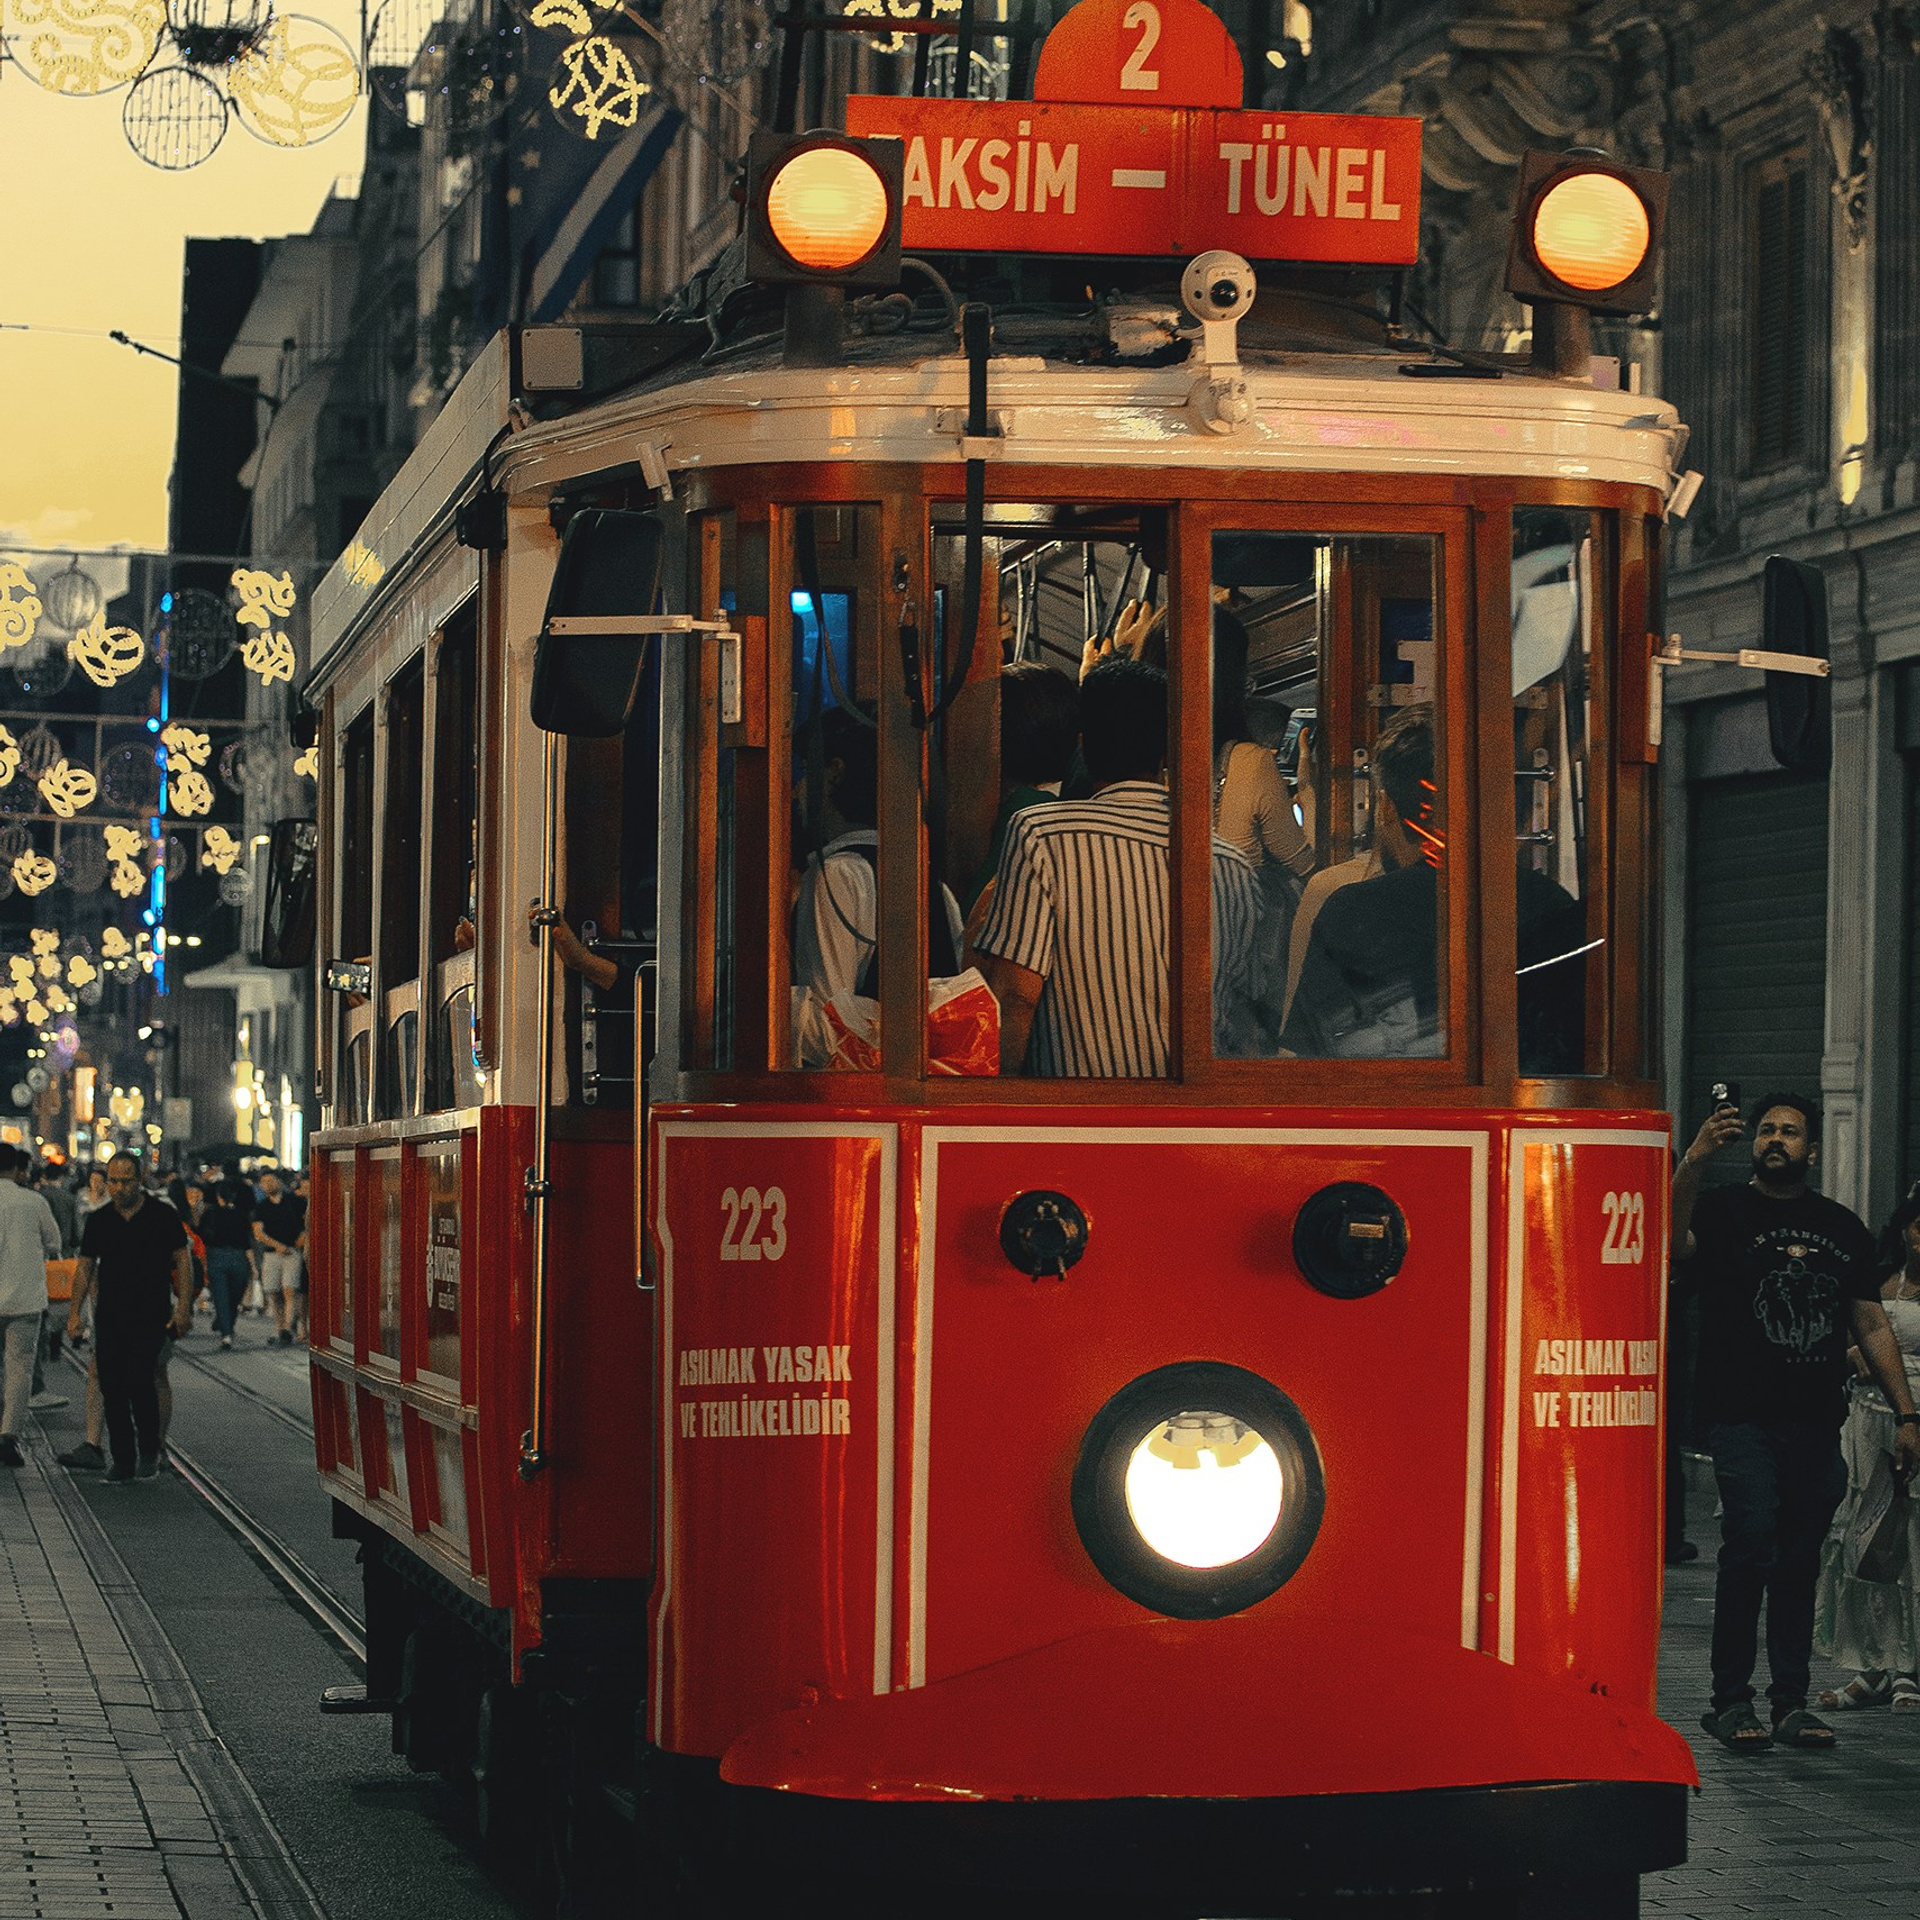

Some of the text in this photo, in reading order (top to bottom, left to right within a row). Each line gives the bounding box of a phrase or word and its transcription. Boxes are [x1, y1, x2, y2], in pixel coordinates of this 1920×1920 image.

[1120, 1, 1161, 91] 2
[868, 119, 1080, 215] AKSİM
[1219, 124, 1402, 221] TÜNEL
[720, 1186, 787, 1261] 223
[1601, 1191, 1645, 1264] 223
[680, 1345, 852, 1385] ASILMAK YASAK
[1534, 1339, 1626, 1375] ASILMAK
[680, 1392, 850, 1438] VE TEHLİKELİDİR
[1532, 1391, 1561, 1427] VE
